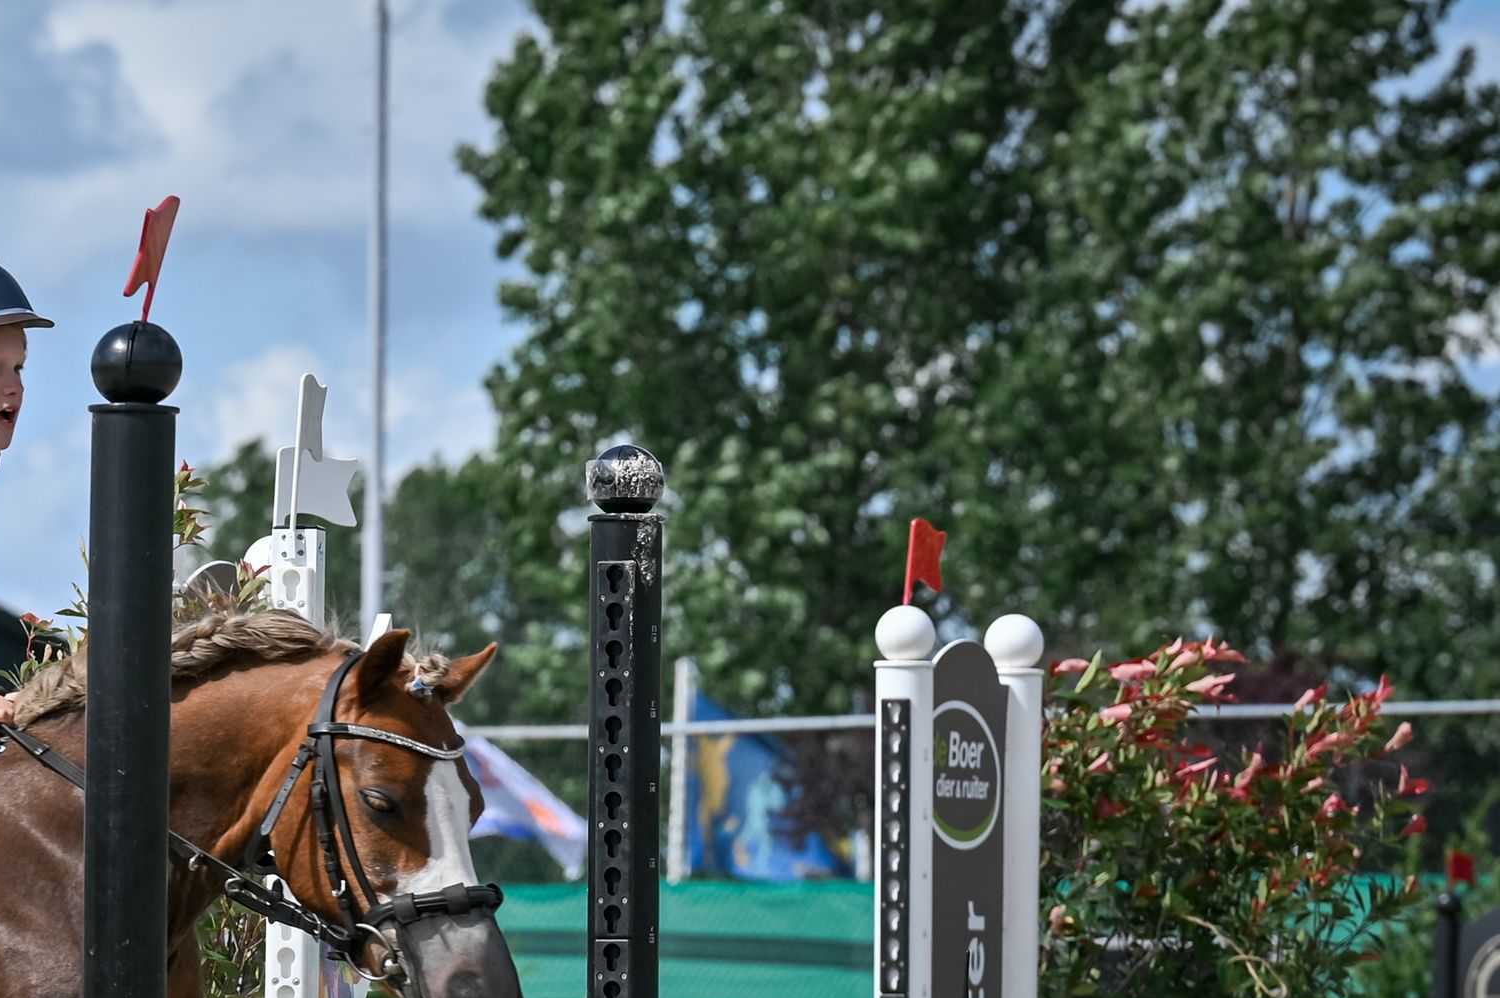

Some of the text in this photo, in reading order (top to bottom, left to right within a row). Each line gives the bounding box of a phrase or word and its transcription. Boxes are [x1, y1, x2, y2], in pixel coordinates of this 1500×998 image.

[948, 731, 985, 769] Boer
[936, 773, 955, 798] dier
[961, 775, 990, 799] ruiter
